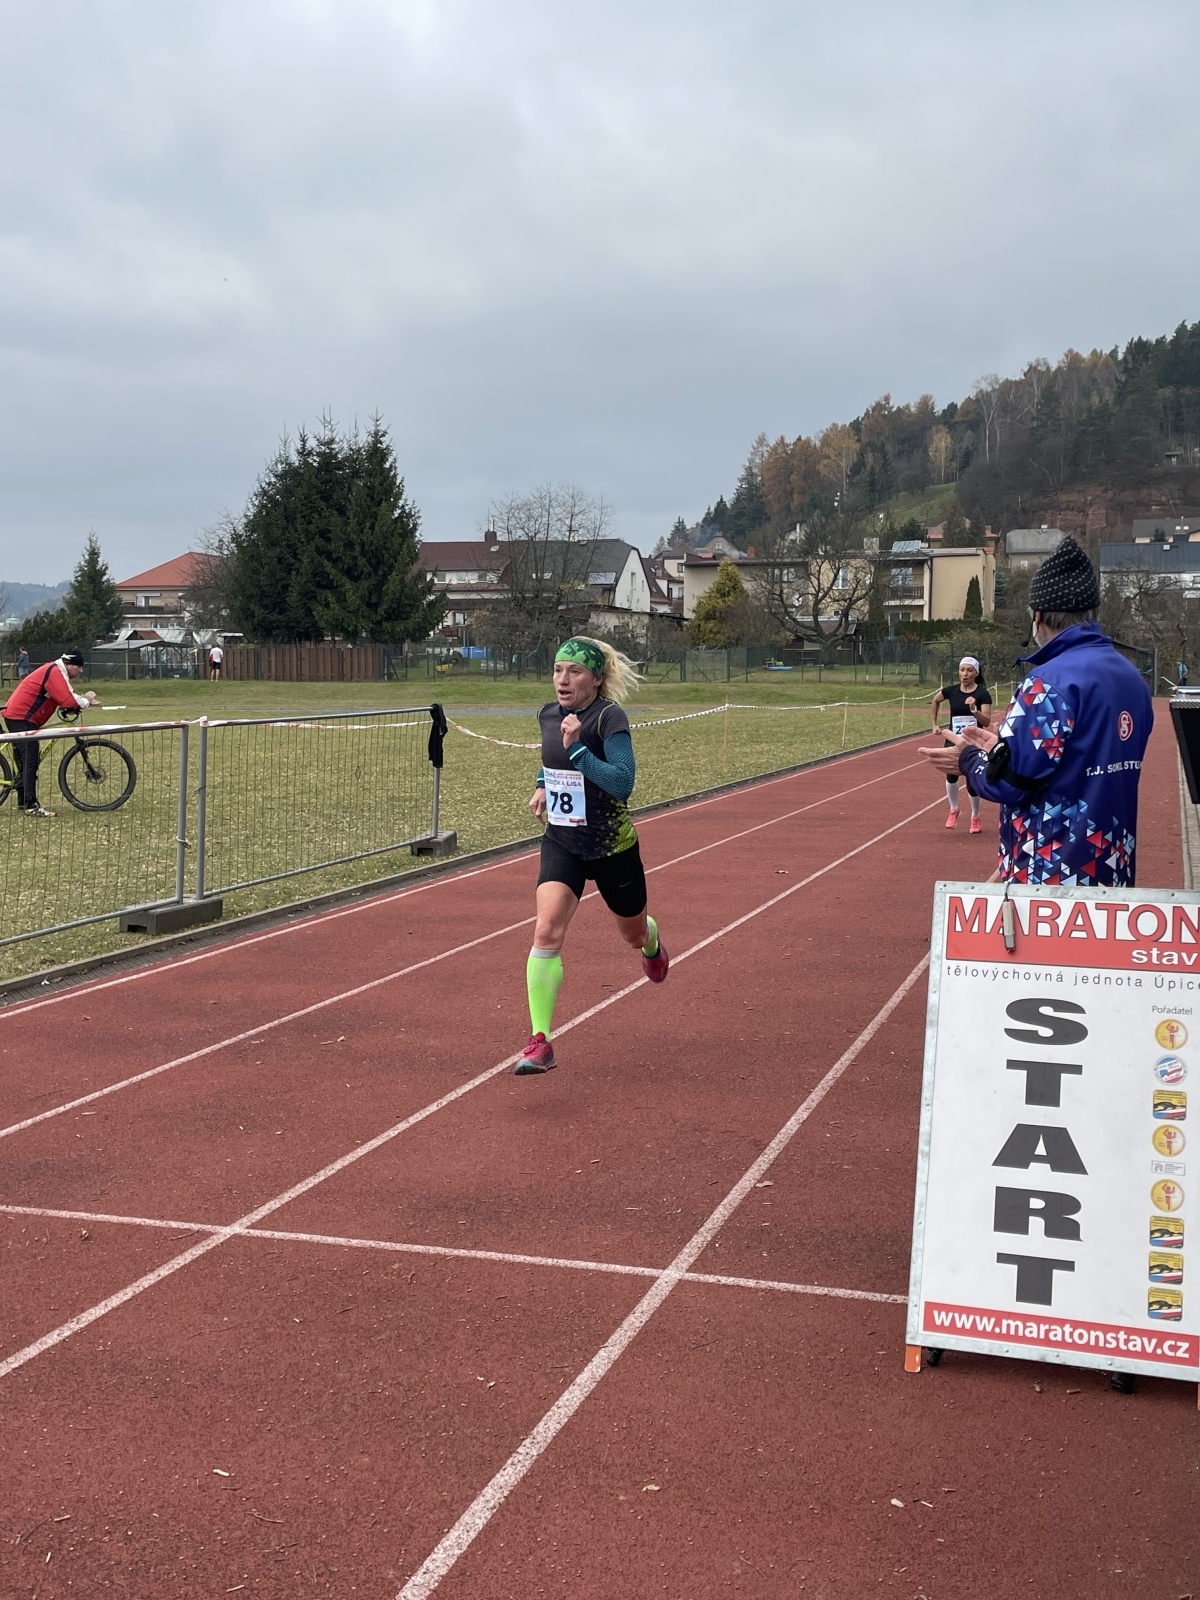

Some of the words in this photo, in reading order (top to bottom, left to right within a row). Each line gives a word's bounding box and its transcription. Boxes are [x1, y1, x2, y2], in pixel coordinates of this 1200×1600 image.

[955, 724, 966, 735] 2
[1085, 765, 1104, 777] T.J.
[1107, 761, 1123, 774] SOKL
[549, 790, 574, 814] 78
[948, 896, 1200, 943] MARATON
[1131, 946, 1199, 966] stav
[946, 965, 1064, 984] tělovýchovná
[1073, 973, 1143, 988] jednota
[1151, 1004, 1193, 1016] Pořadatel
[991, 997, 1089, 1306] START
[933, 1309, 1190, 1359] www.maratonstav.cz
